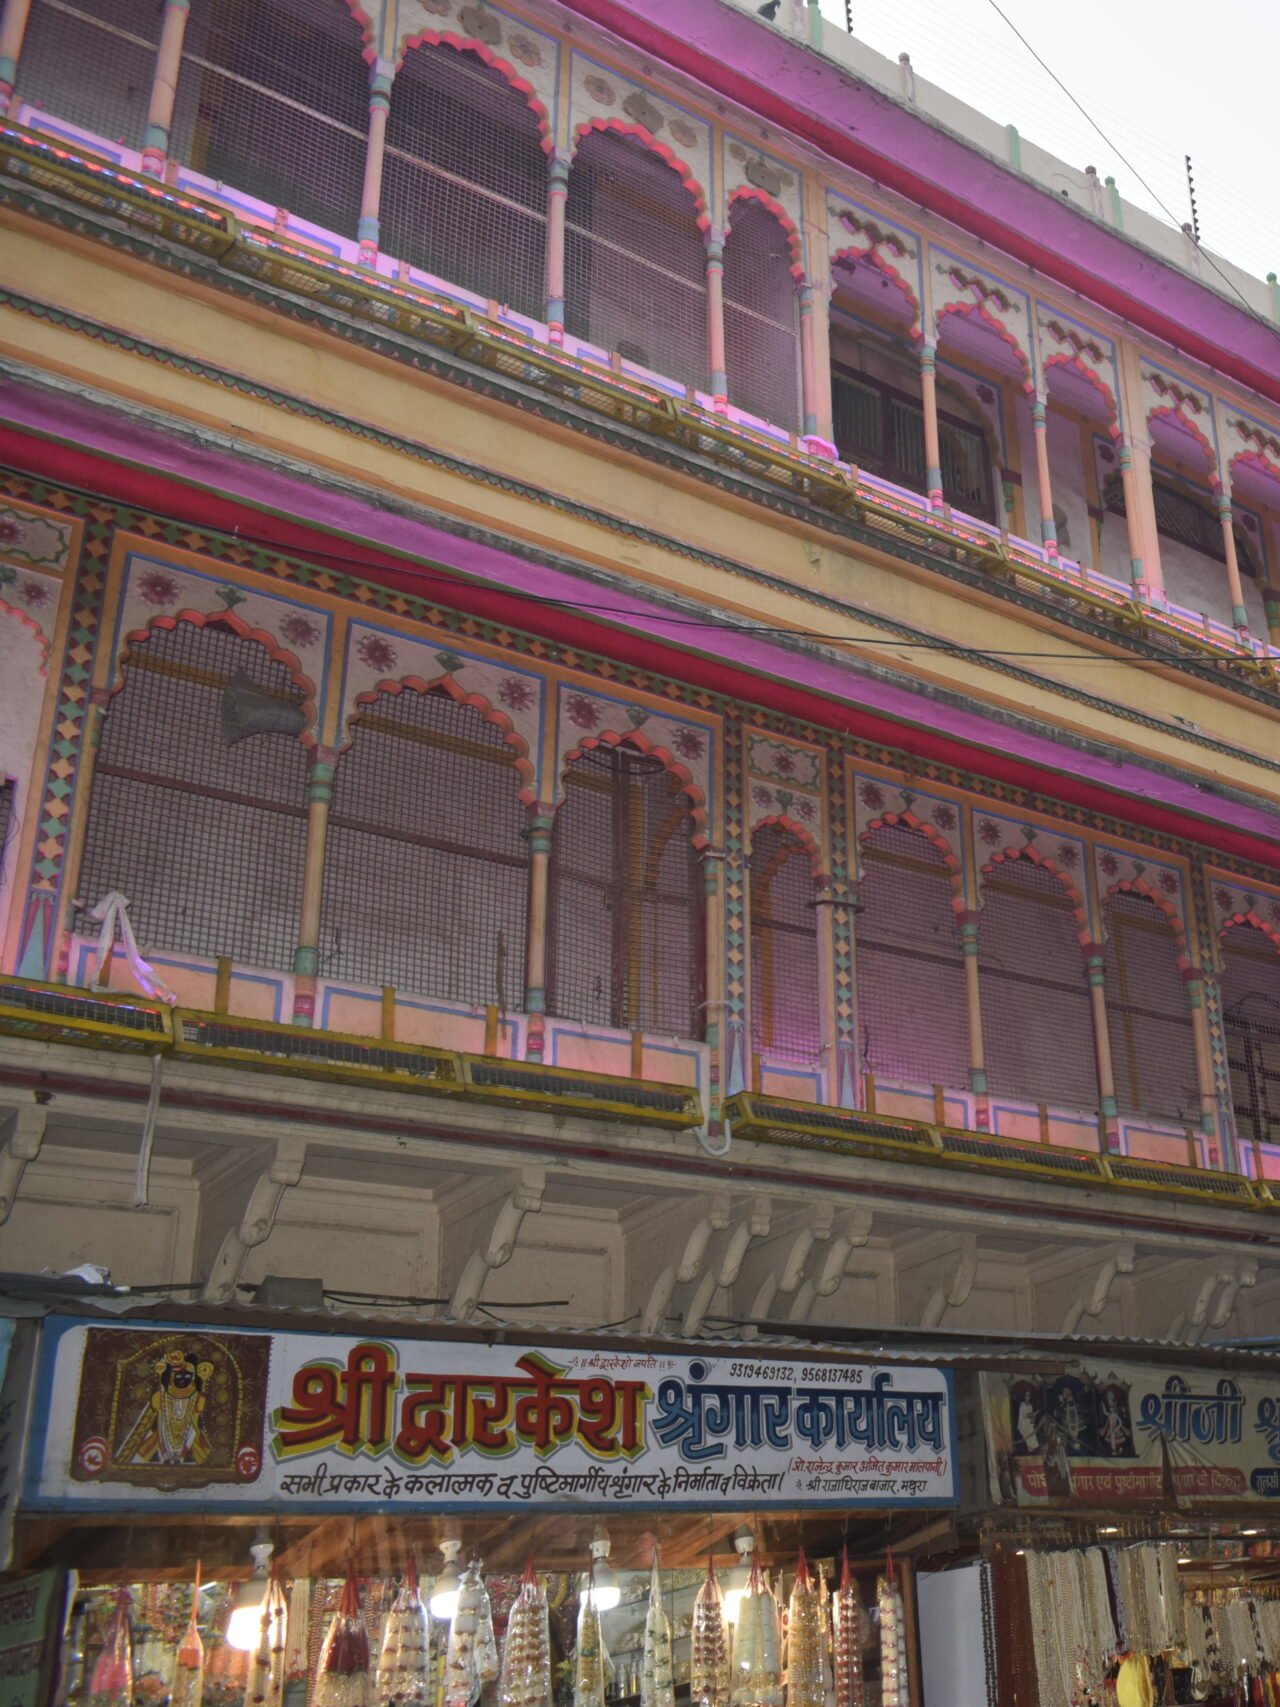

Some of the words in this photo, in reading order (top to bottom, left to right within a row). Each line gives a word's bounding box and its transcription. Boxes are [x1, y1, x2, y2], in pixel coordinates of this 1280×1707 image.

[729, 1363, 797, 1384] 9319469132,
[801, 1366, 864, 1384] 9568137485
[271, 1342, 397, 1459] श्री
[395, 1352, 652, 1467] द्वारकेश
[793, 1371, 946, 1453] कार्यालय
[1136, 1375, 1245, 1443] श्रीजी
[835, 1459, 859, 1475] कुमार
[859, 1456, 885, 1474] अमित
[885, 1460, 908, 1476] कुमार
[281, 1463, 327, 1497] सभी
[327, 1474, 381, 1496] प्रकार
[384, 1466, 404, 1499] के
[406, 1473, 497, 1496] कलात्मक
[497, 1474, 520, 1499] व
[521, 1466, 610, 1499] पुष्टिमार्गीय
[657, 1470, 672, 1499] के
[671, 1467, 719, 1494] निर्माता
[806, 1475, 821, 1492] श्री
[822, 1475, 868, 1494] राजाधिराज
[901, 1479, 928, 1496] मथुरा
